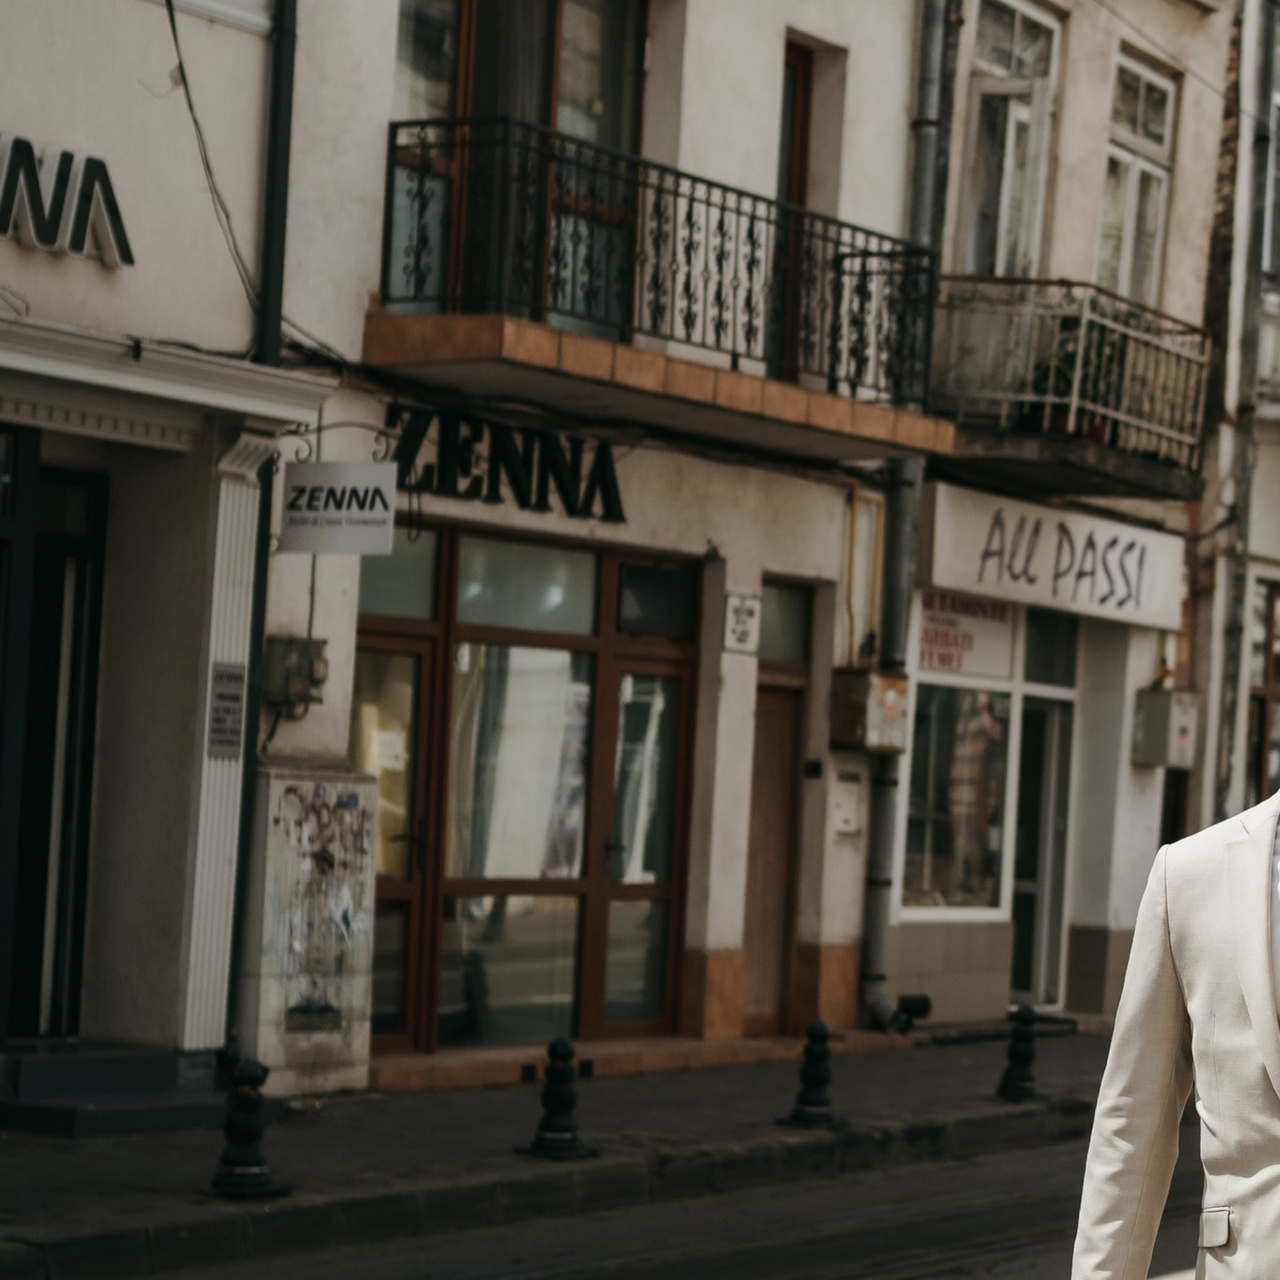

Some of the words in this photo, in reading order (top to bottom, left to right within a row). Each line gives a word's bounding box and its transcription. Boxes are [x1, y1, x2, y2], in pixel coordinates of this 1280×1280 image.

[286, 485, 389, 512] ZENNA
[385, 399, 626, 524] ZENNA
[1052, 521, 1147, 609] PASSI
